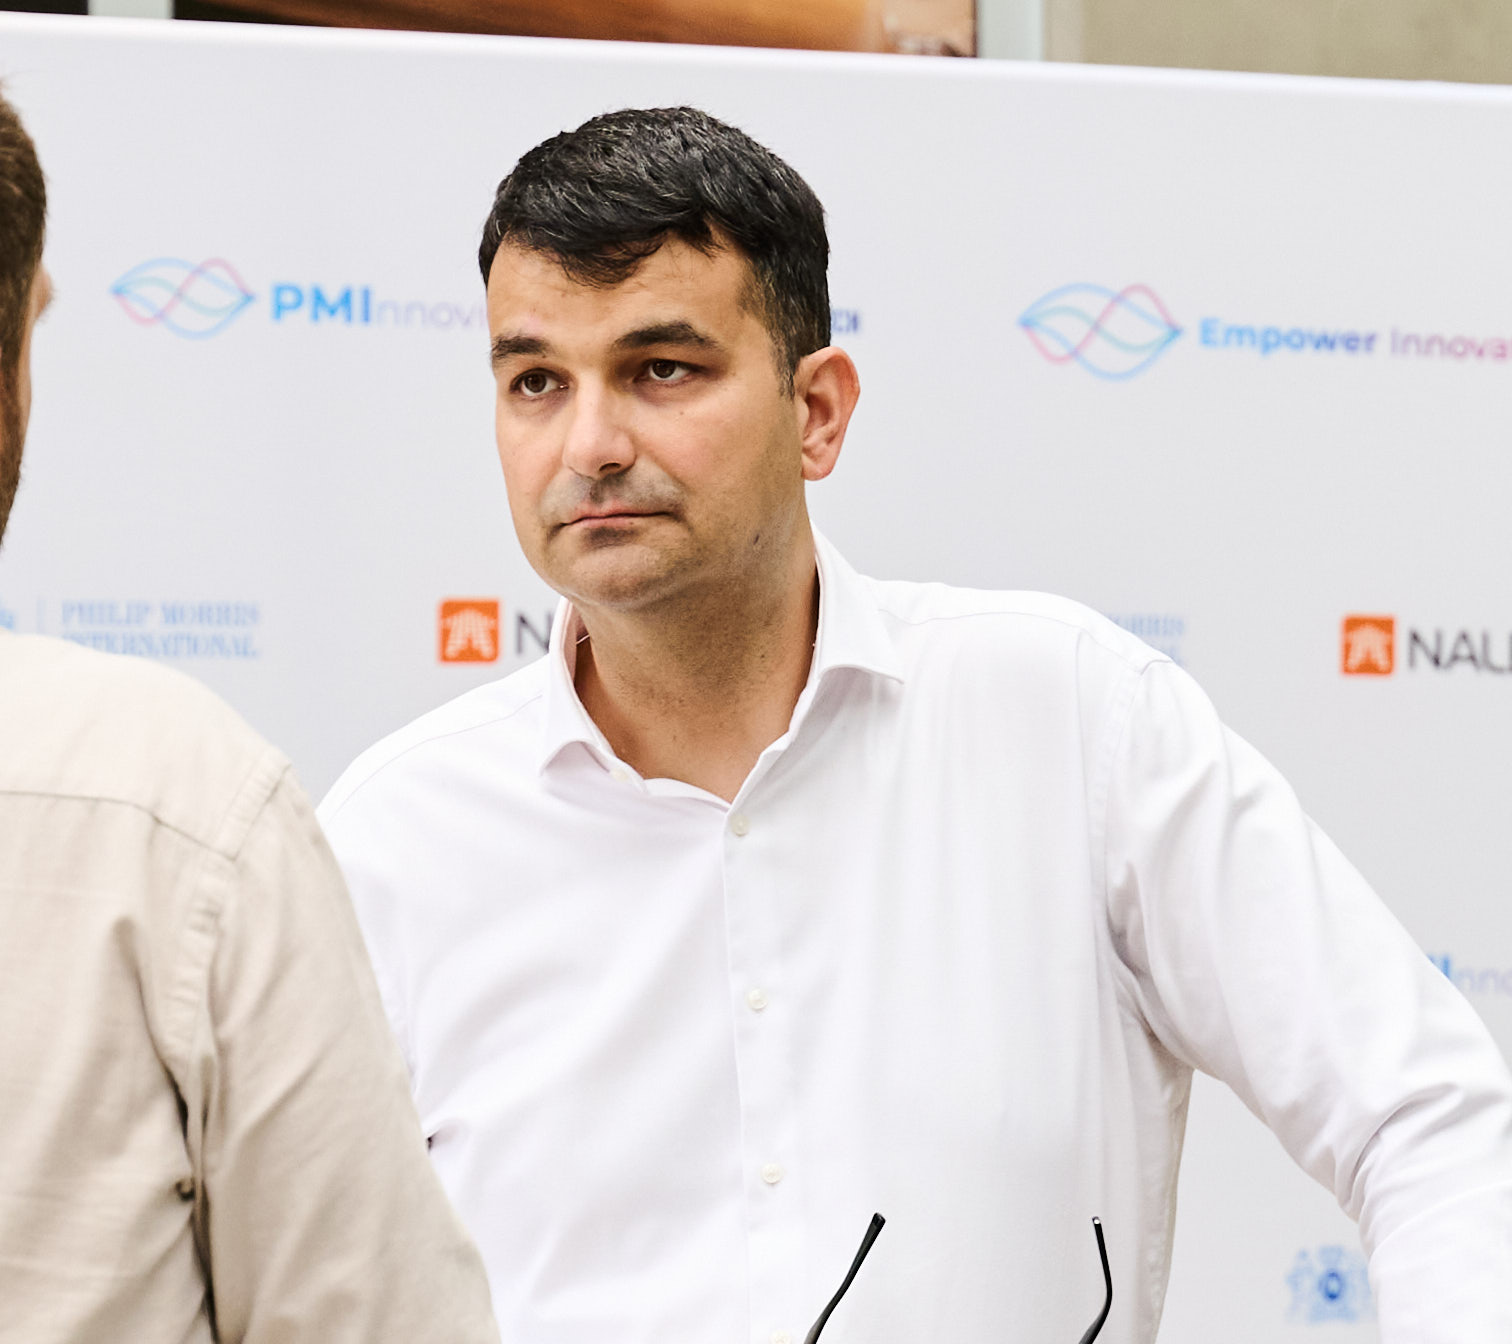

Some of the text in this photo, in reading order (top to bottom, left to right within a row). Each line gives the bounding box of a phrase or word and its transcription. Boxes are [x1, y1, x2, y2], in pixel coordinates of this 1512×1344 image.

[271, 283, 488, 328] PMInnovi
[1199, 317, 1377, 357] Empower
[61, 599, 260, 627] PHILIP MORRIS
